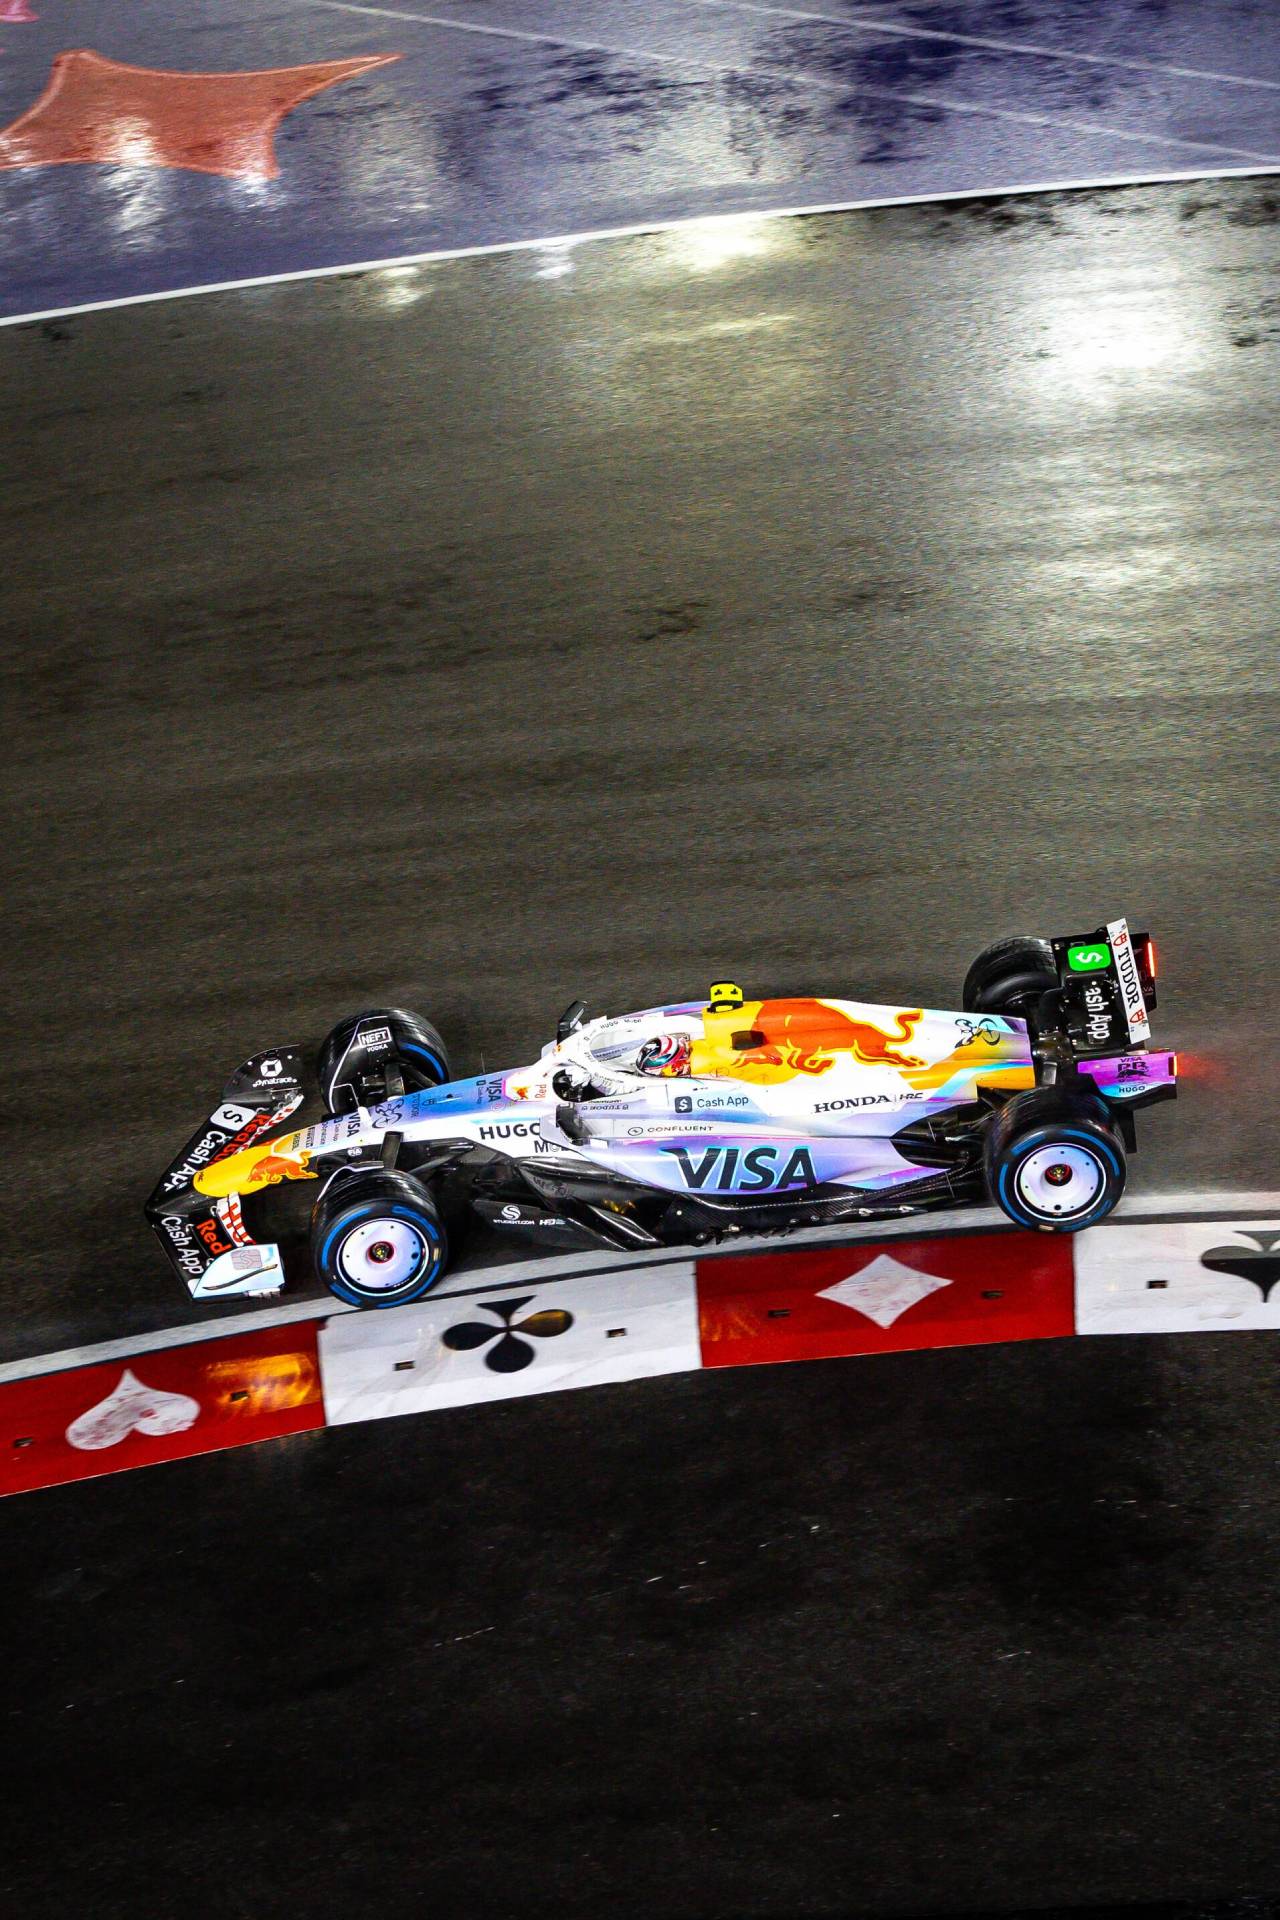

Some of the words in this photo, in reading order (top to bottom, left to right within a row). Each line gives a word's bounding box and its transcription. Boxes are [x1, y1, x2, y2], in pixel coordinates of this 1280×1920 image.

[1118, 947, 1140, 1009] TUDOR
[1085, 981, 1109, 1012] ash
[361, 1030, 387, 1045] NEFT
[1086, 1014, 1112, 1039] App
[366, 1044, 389, 1053] VODKA
[254, 1076, 294, 1087] dynatrace
[486, 1078, 503, 1103] VISA
[1118, 1085, 1146, 1093] HUGO
[696, 1098, 725, 1108] Cash
[726, 1095, 749, 1106] App
[813, 1095, 892, 1113] HONDA
[347, 1112, 361, 1137] VISA
[647, 1125, 715, 1133] CONFLUENT
[186, 1130, 226, 1164] Cash
[660, 1147, 818, 1191] VISA
[161, 1216, 193, 1246] Cash
[178, 1247, 204, 1275] App
[196, 1219, 233, 1256] Red
